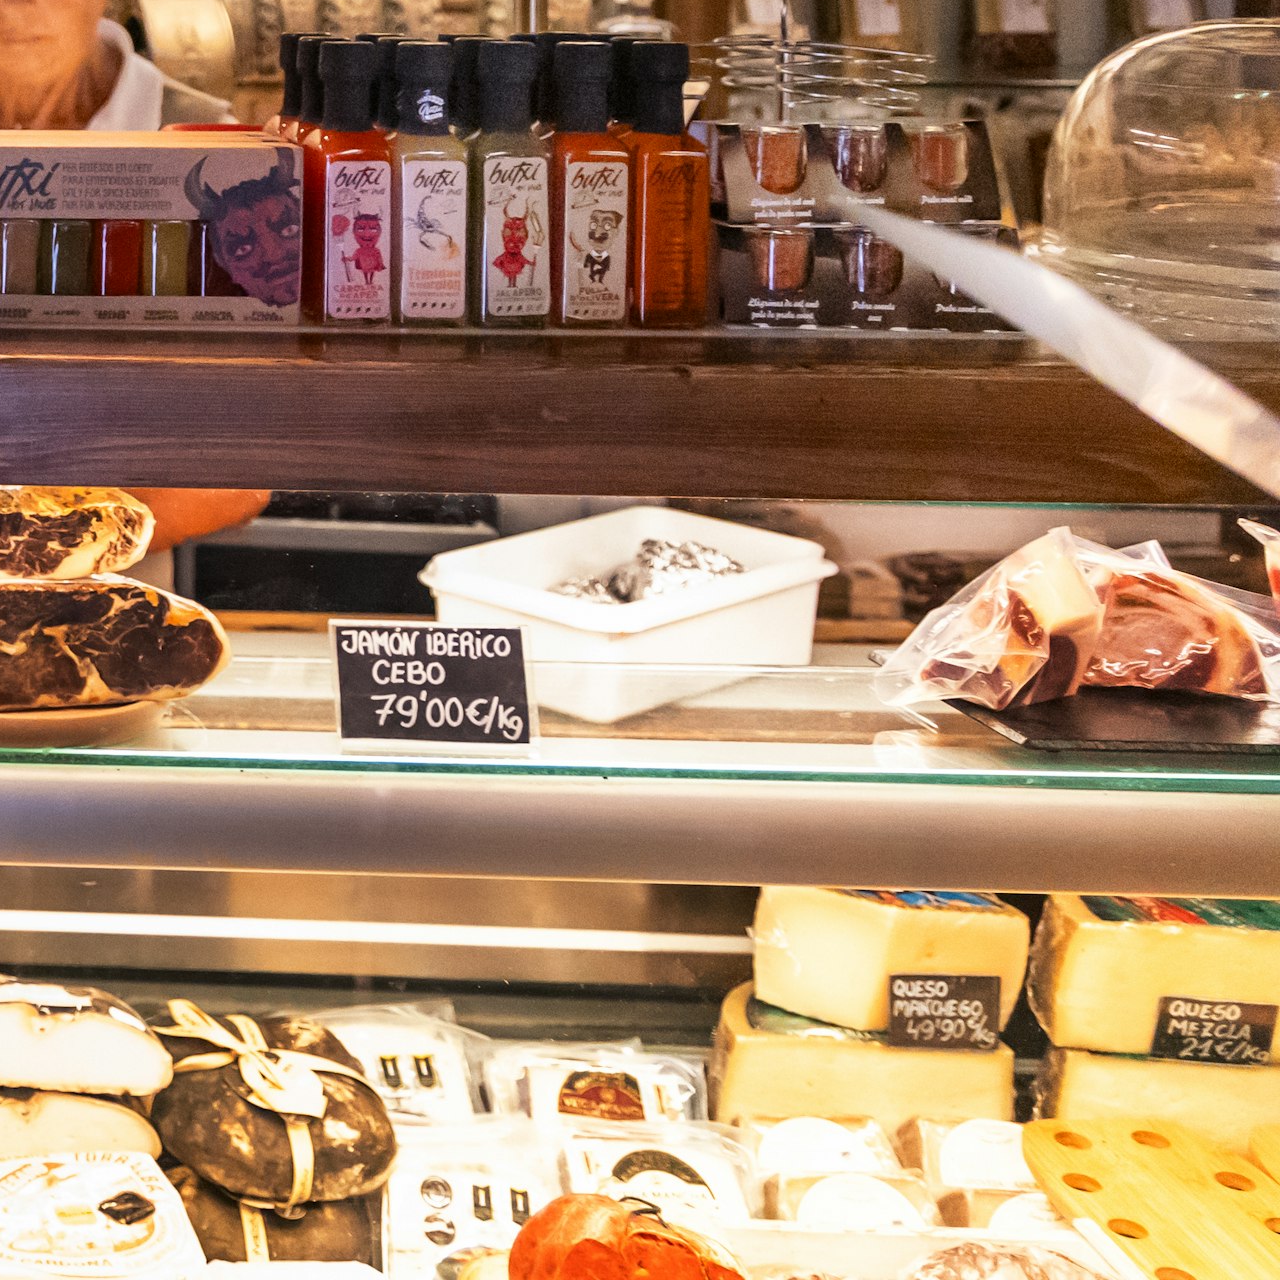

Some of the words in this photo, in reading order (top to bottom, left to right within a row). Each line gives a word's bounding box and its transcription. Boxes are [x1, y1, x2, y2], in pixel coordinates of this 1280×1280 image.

[341, 627, 420, 657] JAMÓN
[371, 659, 446, 686] CEBO
[892, 979, 949, 998] QUESO
[893, 999, 983, 1018] MANCHEGO
[1168, 1000, 1241, 1021] QUESO
[1167, 1018, 1251, 1040] MEZCLA
